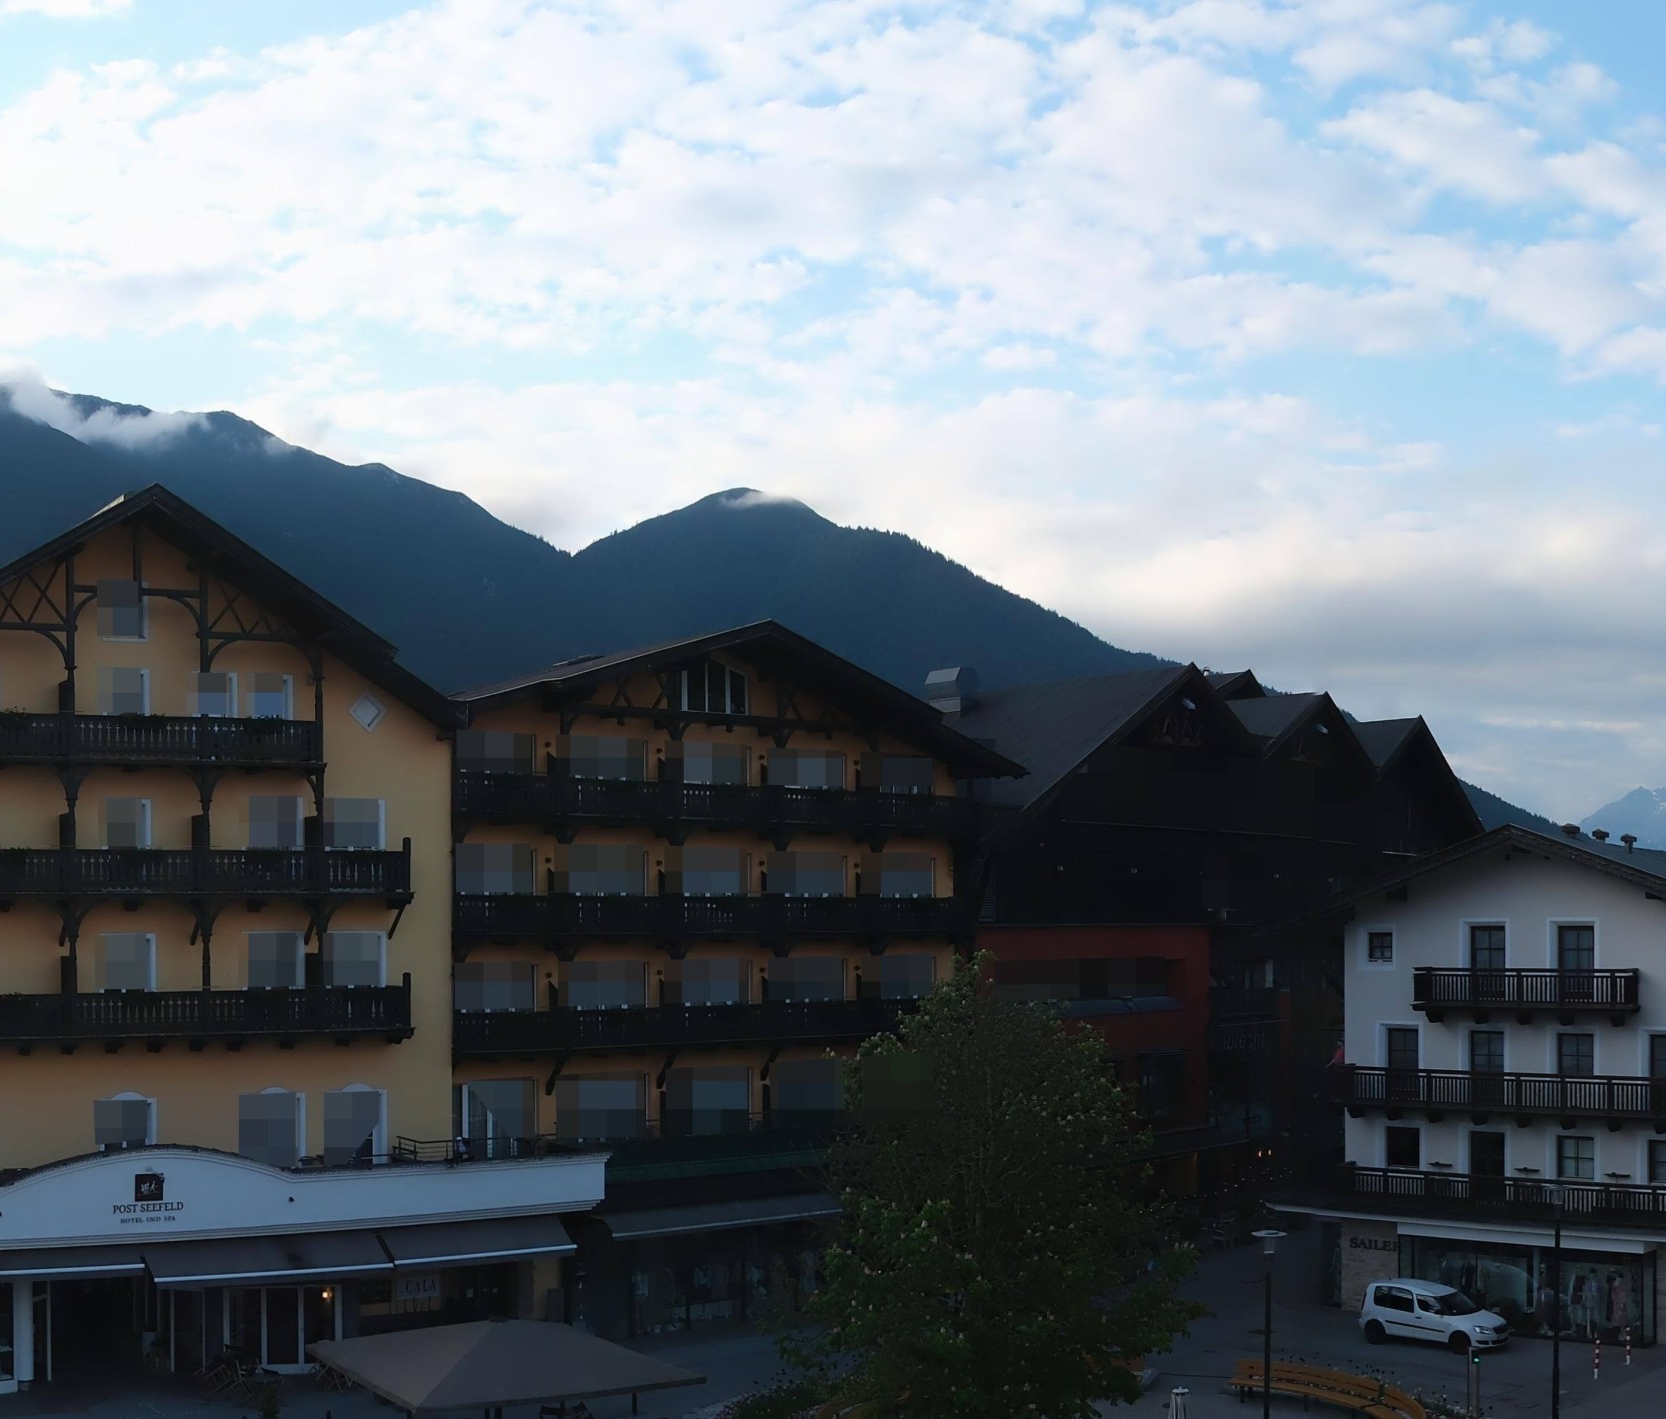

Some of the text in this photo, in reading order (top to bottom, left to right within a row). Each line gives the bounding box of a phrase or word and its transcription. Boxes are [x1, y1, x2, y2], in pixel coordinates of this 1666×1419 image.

[113, 1202, 184, 1214] POST SEEFELD
[406, 1280, 436, 1294] CALA
